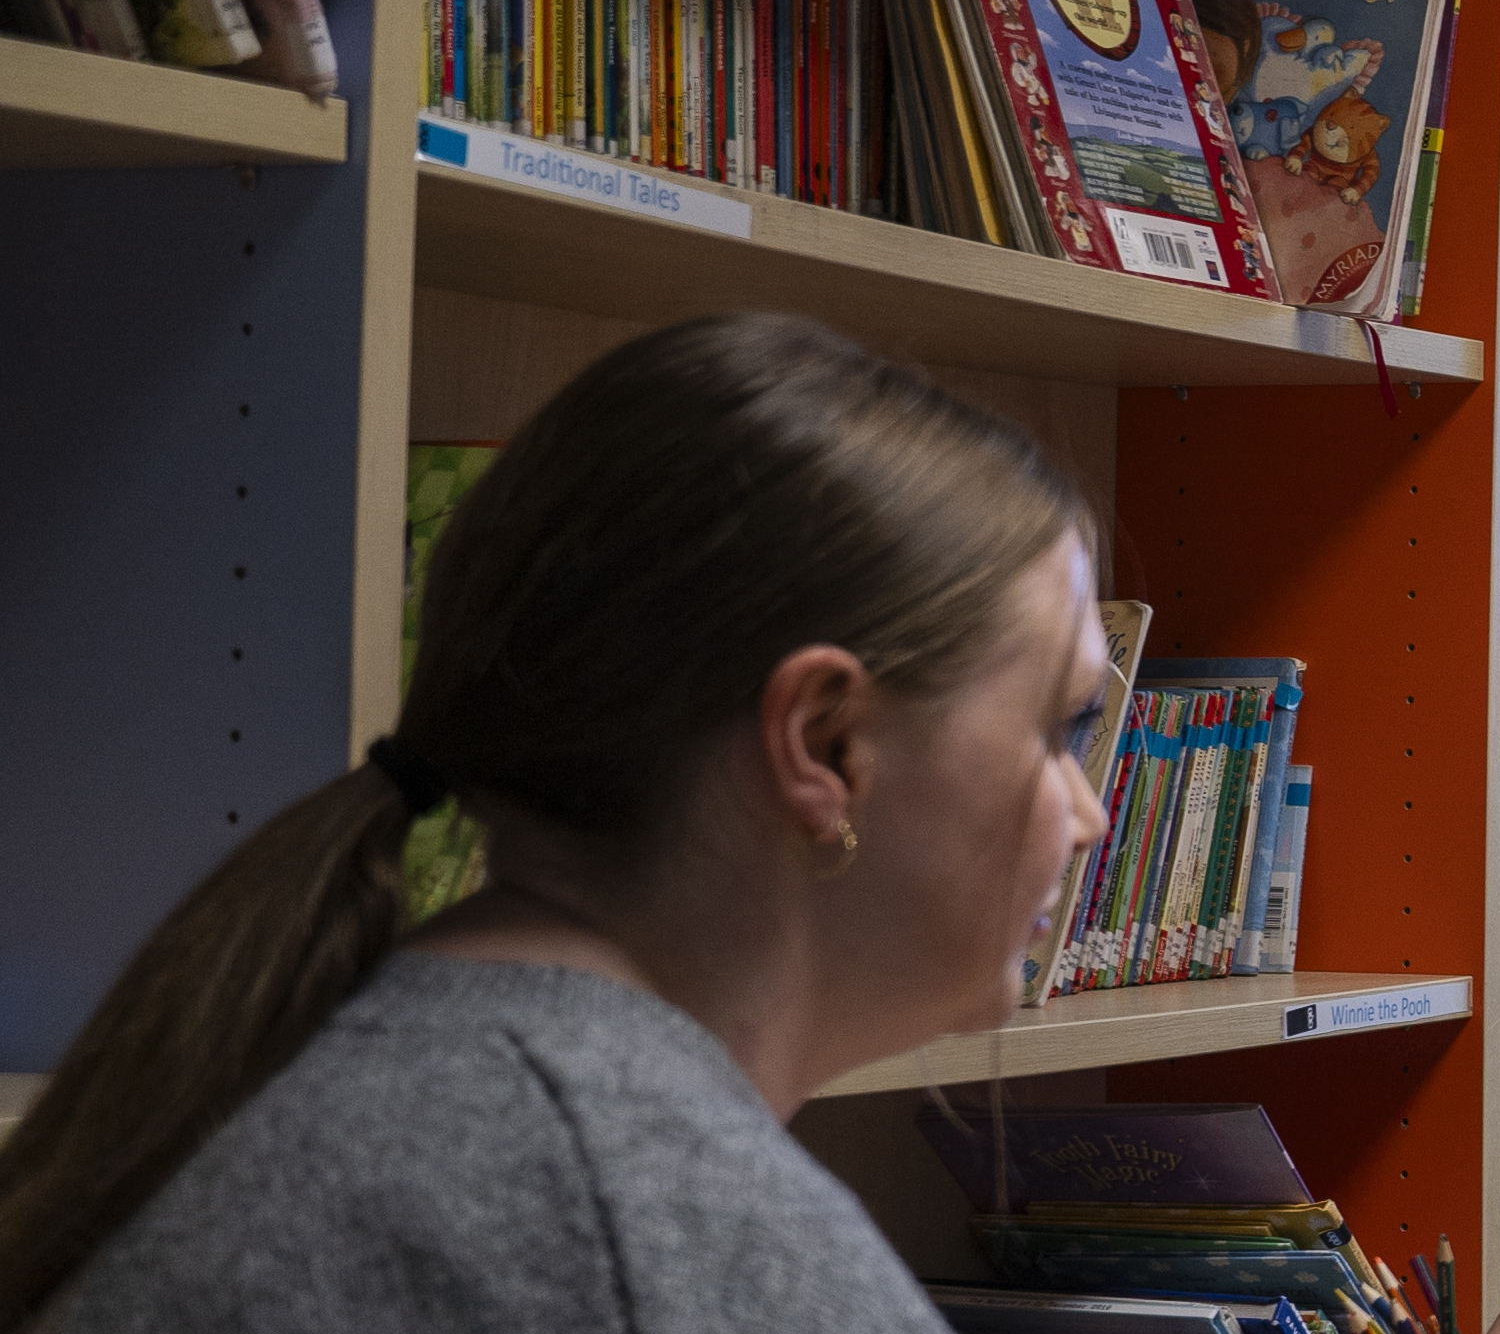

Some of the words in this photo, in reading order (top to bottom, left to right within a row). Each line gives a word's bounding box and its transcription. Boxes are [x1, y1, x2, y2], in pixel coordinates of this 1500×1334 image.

[501, 142, 622, 198] Traditional
[629, 174, 680, 212] Tales
[1316, 244, 1379, 299] MYRIAD
[1331, 1001, 1375, 1026] Winnie
[1378, 1000, 1398, 1020] the
[1401, 994, 1431, 1017] Pooh
[1030, 1136, 1099, 1172] Tooth
[1104, 1134, 1182, 1171] Fairy
[1073, 1161, 1159, 1192] Magic
